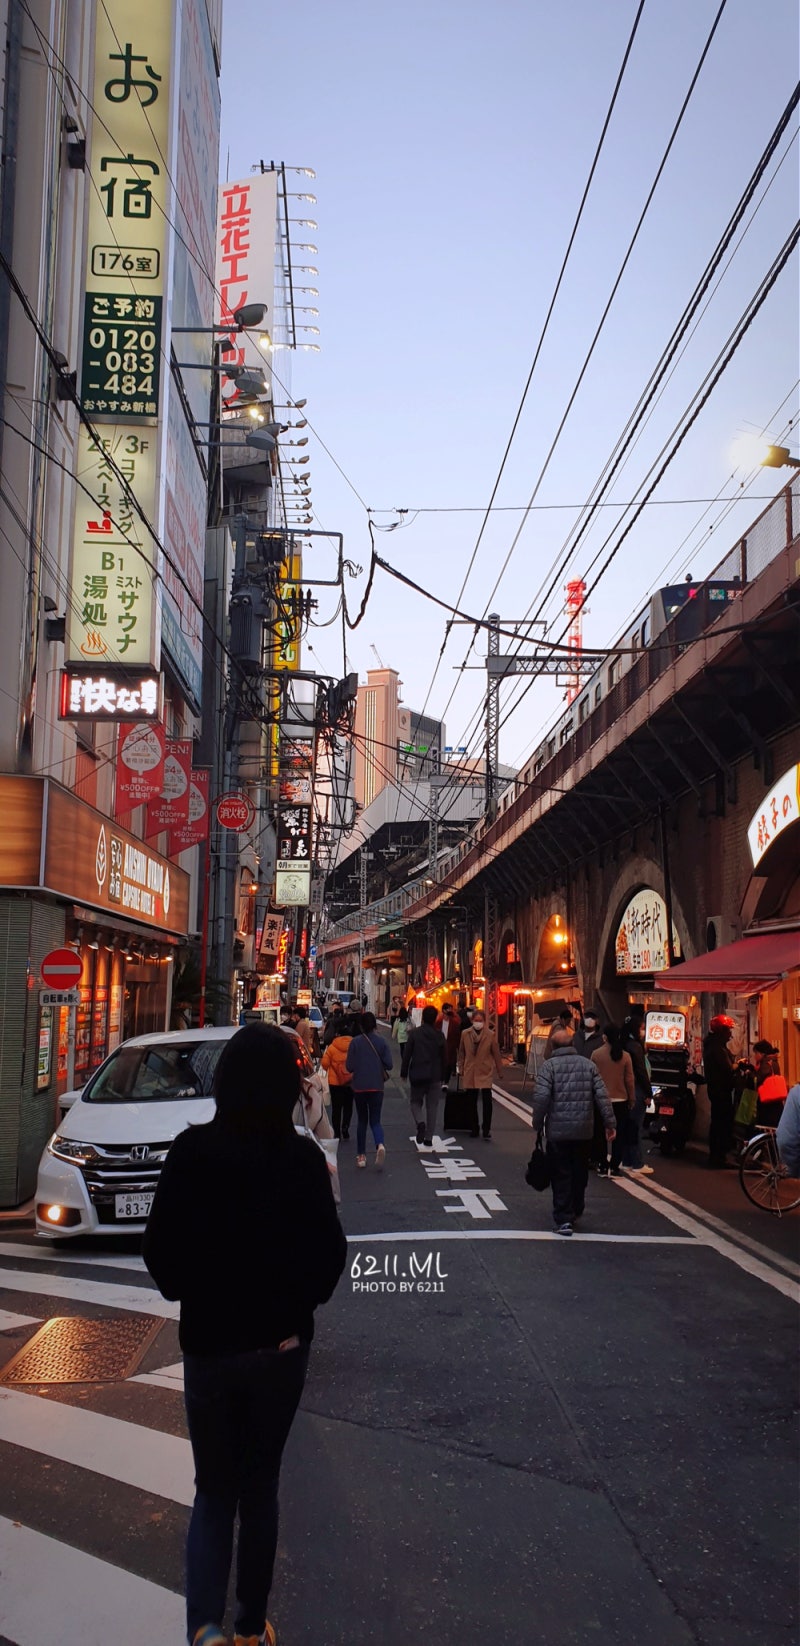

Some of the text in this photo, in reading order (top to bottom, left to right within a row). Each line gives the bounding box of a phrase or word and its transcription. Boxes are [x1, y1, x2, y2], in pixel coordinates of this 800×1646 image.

[101, 43, 162, 219] お宿
[98, 251, 153, 273] 176室
[92, 298, 155, 317] ご予約
[89, 328, 156, 351] 0120
[89, 352, 155, 374] -083
[88, 375, 155, 396] -484
[83, 400, 157, 414] おやすみ新橋
[97, 457, 113, 508] スペース
[101, 551, 124, 571] B1
[115, 576, 143, 588] ミスト
[81, 574, 109, 627] 湯処
[116, 591, 139, 654] サウナ
[220, 807, 247, 819] 消火栓
[631, 901, 661, 947] 新時代
